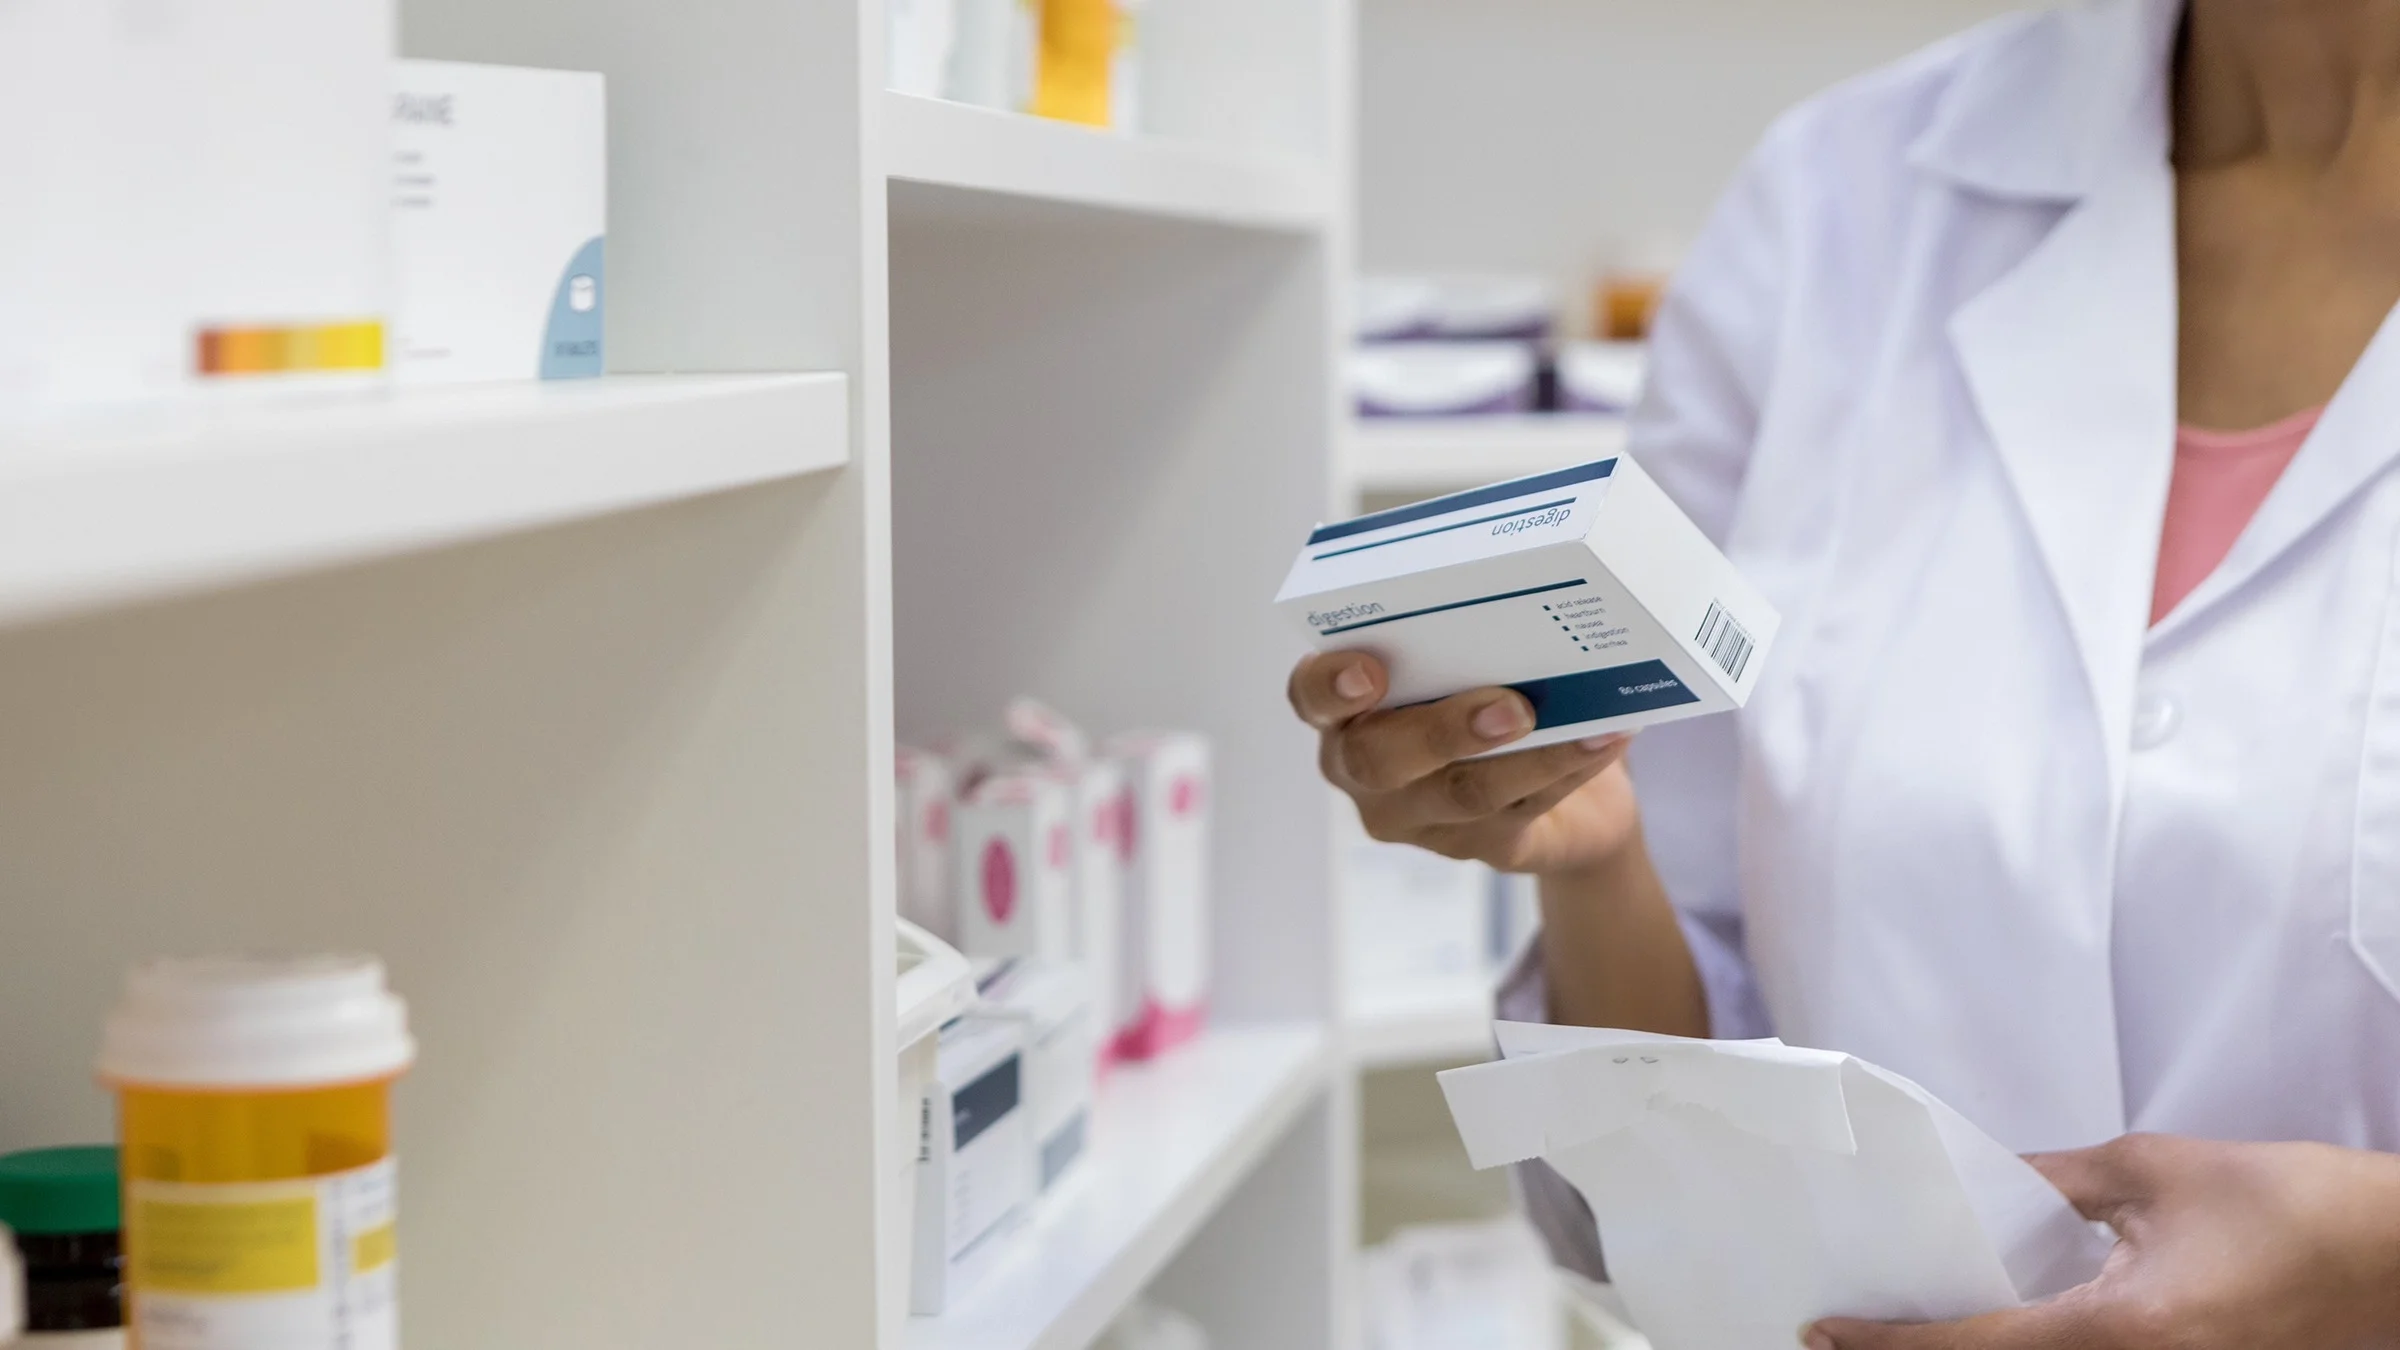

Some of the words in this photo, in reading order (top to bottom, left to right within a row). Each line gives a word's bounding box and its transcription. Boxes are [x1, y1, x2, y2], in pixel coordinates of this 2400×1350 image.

[1491, 507, 1571, 537] digestion
[1556, 599, 1573, 609] acid
[1573, 596, 1603, 606] release
[1307, 602, 1386, 627] digestion
[1563, 607, 1606, 619] heartburn
[1575, 620, 1604, 630] nausea
[1584, 627, 1630, 639] indigestion
[1593, 640, 1628, 650] diarrhea
[1634, 679, 1678, 693] capsules
